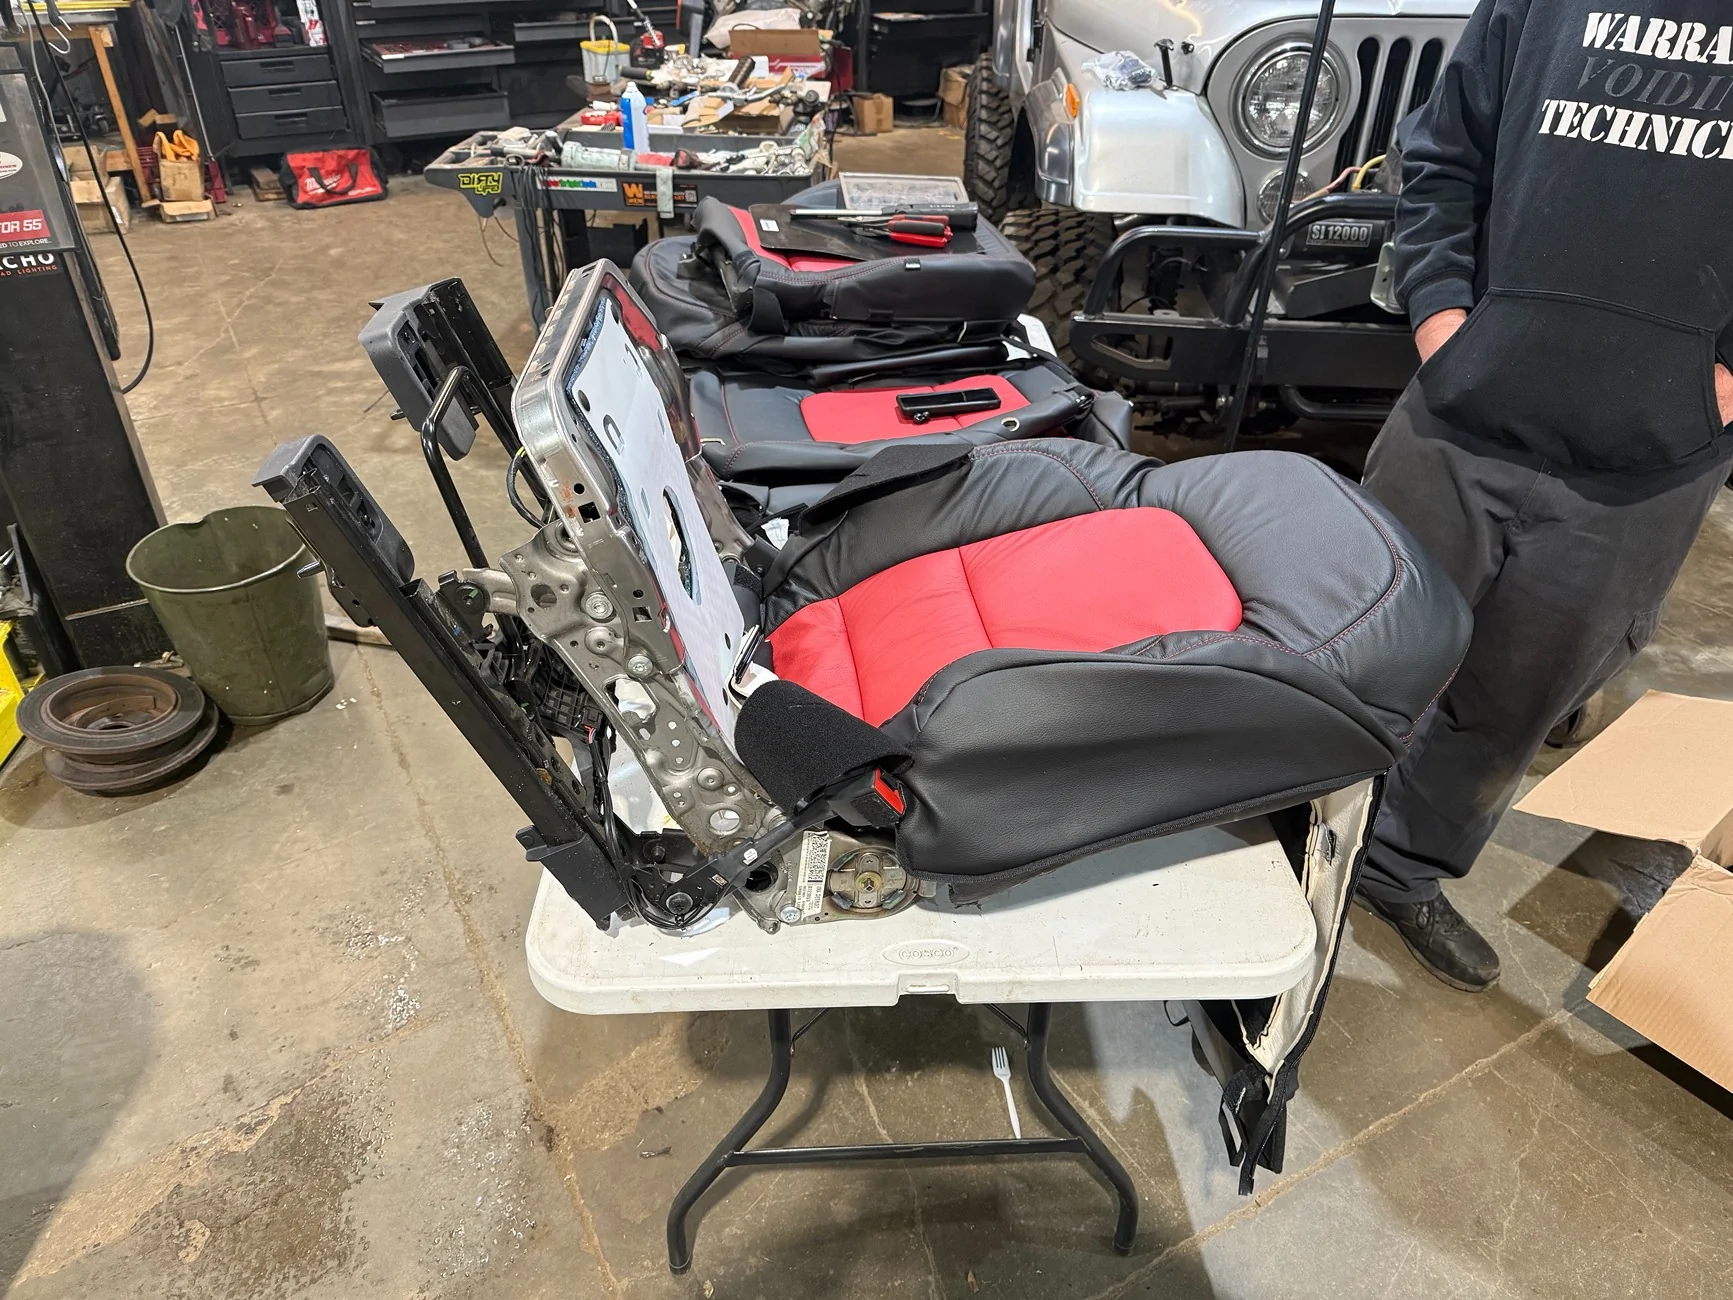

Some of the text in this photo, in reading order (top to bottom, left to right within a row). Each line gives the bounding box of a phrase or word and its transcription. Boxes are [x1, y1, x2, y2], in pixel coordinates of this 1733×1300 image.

[1582, 12, 1733, 64] WARRA
[0, 218, 42, 233] OR 55
[0, 252, 55, 271] CHO
[17, 264, 57, 275] LIGHTING
[898, 948, 955, 960] COSCO
